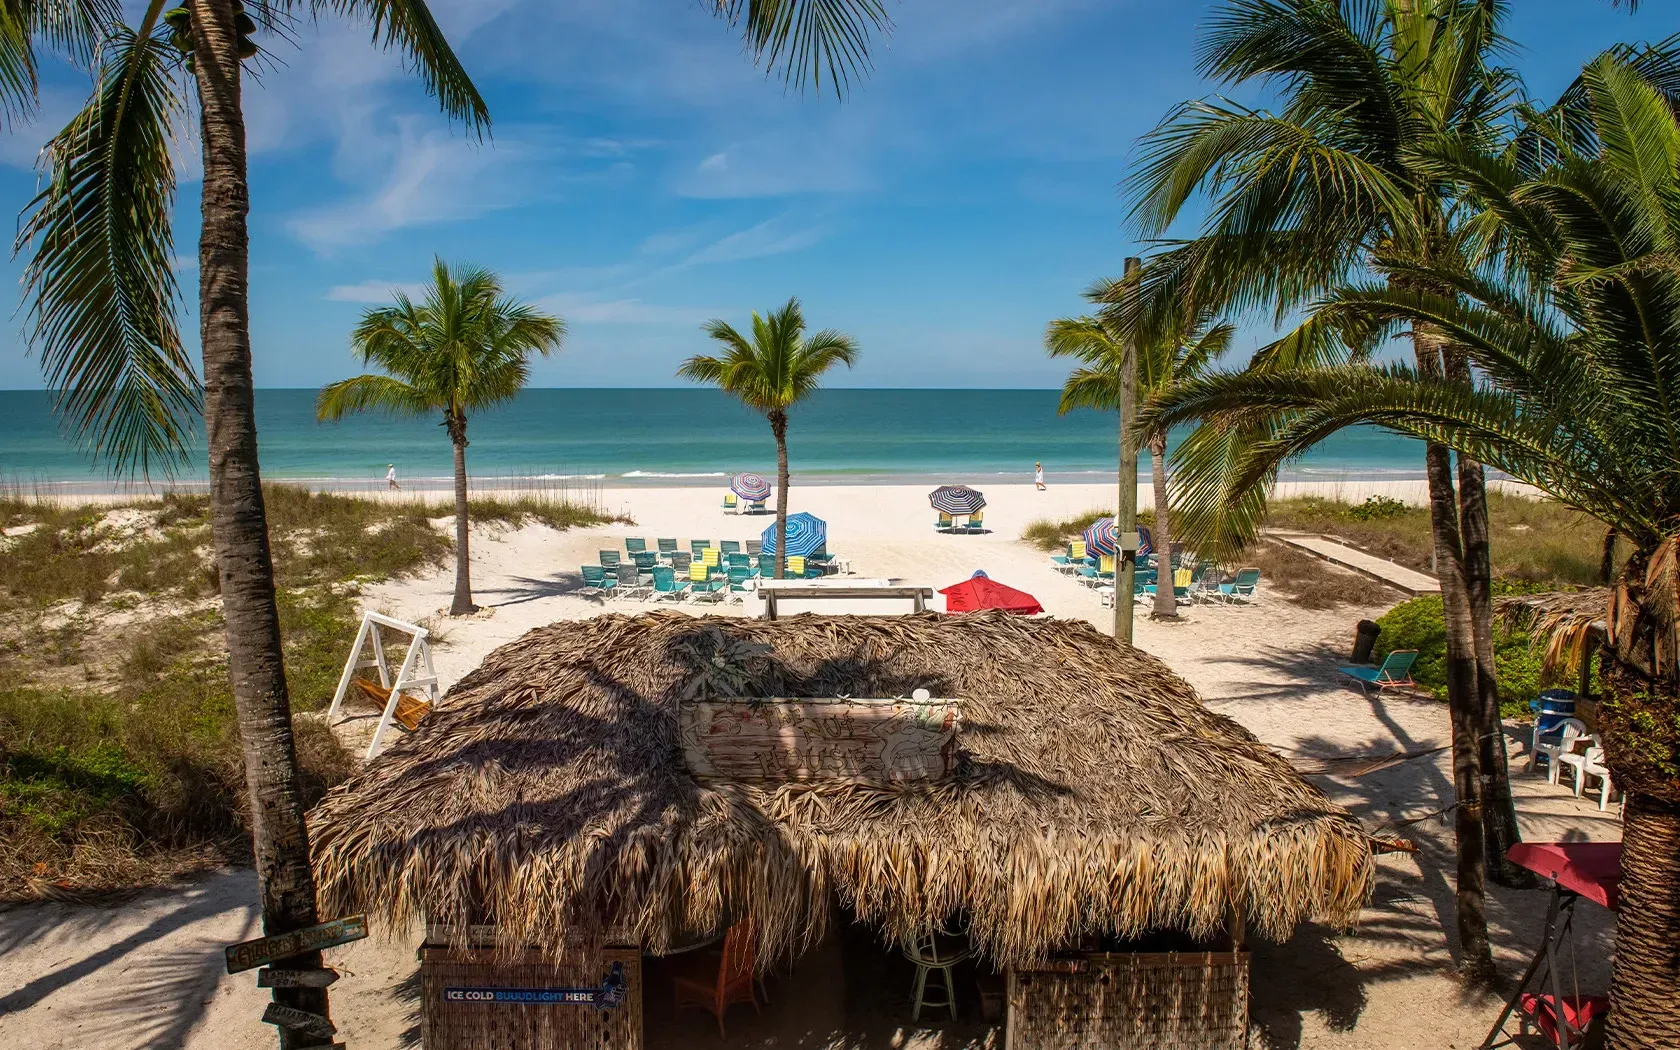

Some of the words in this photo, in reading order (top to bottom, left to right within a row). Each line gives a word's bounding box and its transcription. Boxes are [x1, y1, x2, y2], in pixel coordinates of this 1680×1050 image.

[755, 744, 881, 776] HOUSE
[447, 991, 463, 999] ICE
[465, 991, 494, 1000] COLD
[496, 992, 564, 1001] BUUUDLIGHT
[565, 993, 594, 1002] HERE
